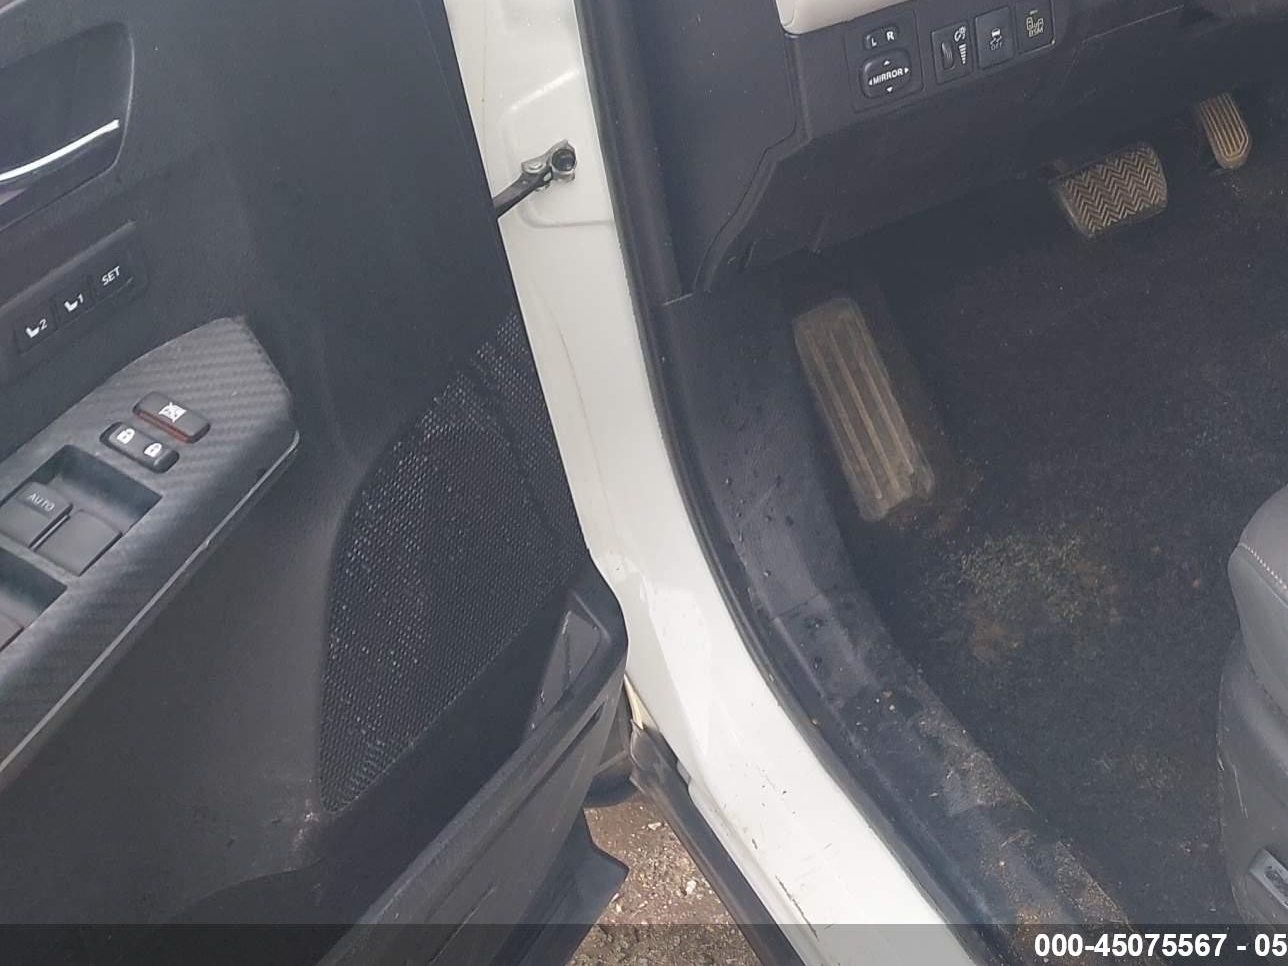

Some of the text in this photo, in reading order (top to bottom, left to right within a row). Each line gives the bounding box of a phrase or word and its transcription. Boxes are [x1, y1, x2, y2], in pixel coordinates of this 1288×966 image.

[871, 31, 895, 47] L R
[873, 68, 904, 85] MIRROR
[101, 265, 121, 286] SET
[39, 318, 48, 331] 2
